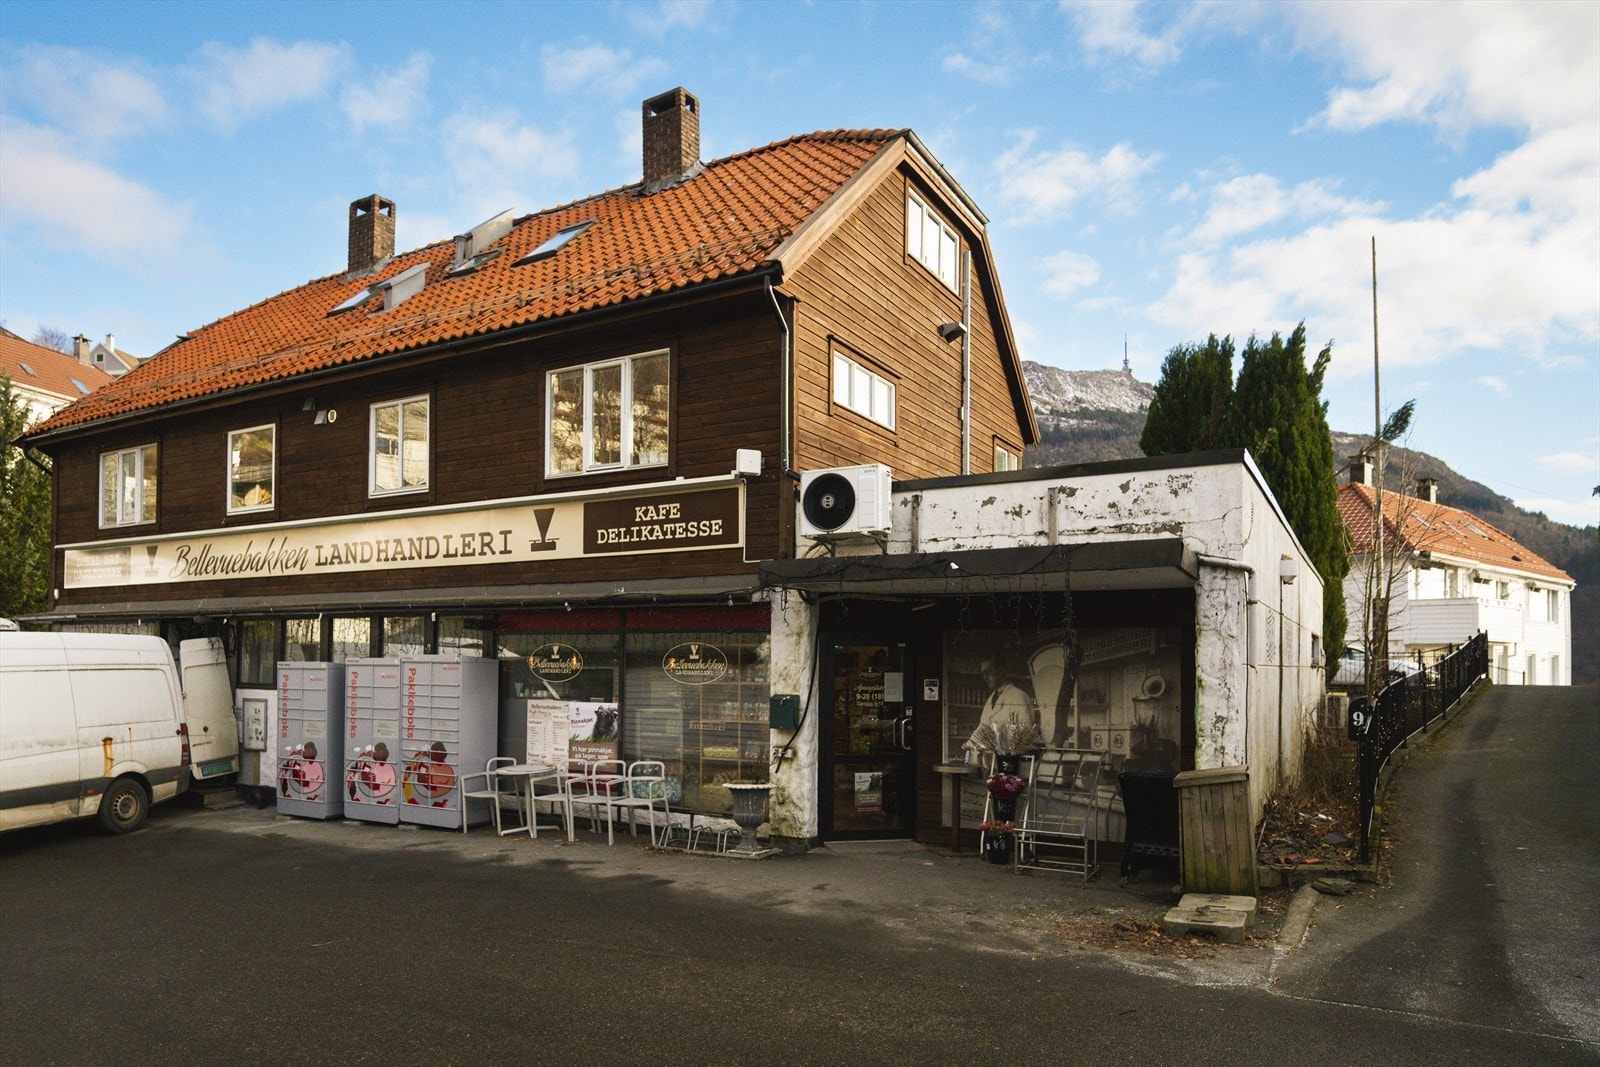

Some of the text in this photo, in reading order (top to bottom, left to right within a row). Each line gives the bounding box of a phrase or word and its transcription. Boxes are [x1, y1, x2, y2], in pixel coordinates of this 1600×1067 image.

[597, 520, 723, 544] DELIKATESSE
[635, 503, 681, 522] KAFE
[168, 529, 513, 578] Bellevuebakken LANDHANDLERI
[281, 674, 289, 738] Pakkeboks
[350, 671, 359, 739] Pakkeboks
[406, 667, 417, 739] Pakkeboks
